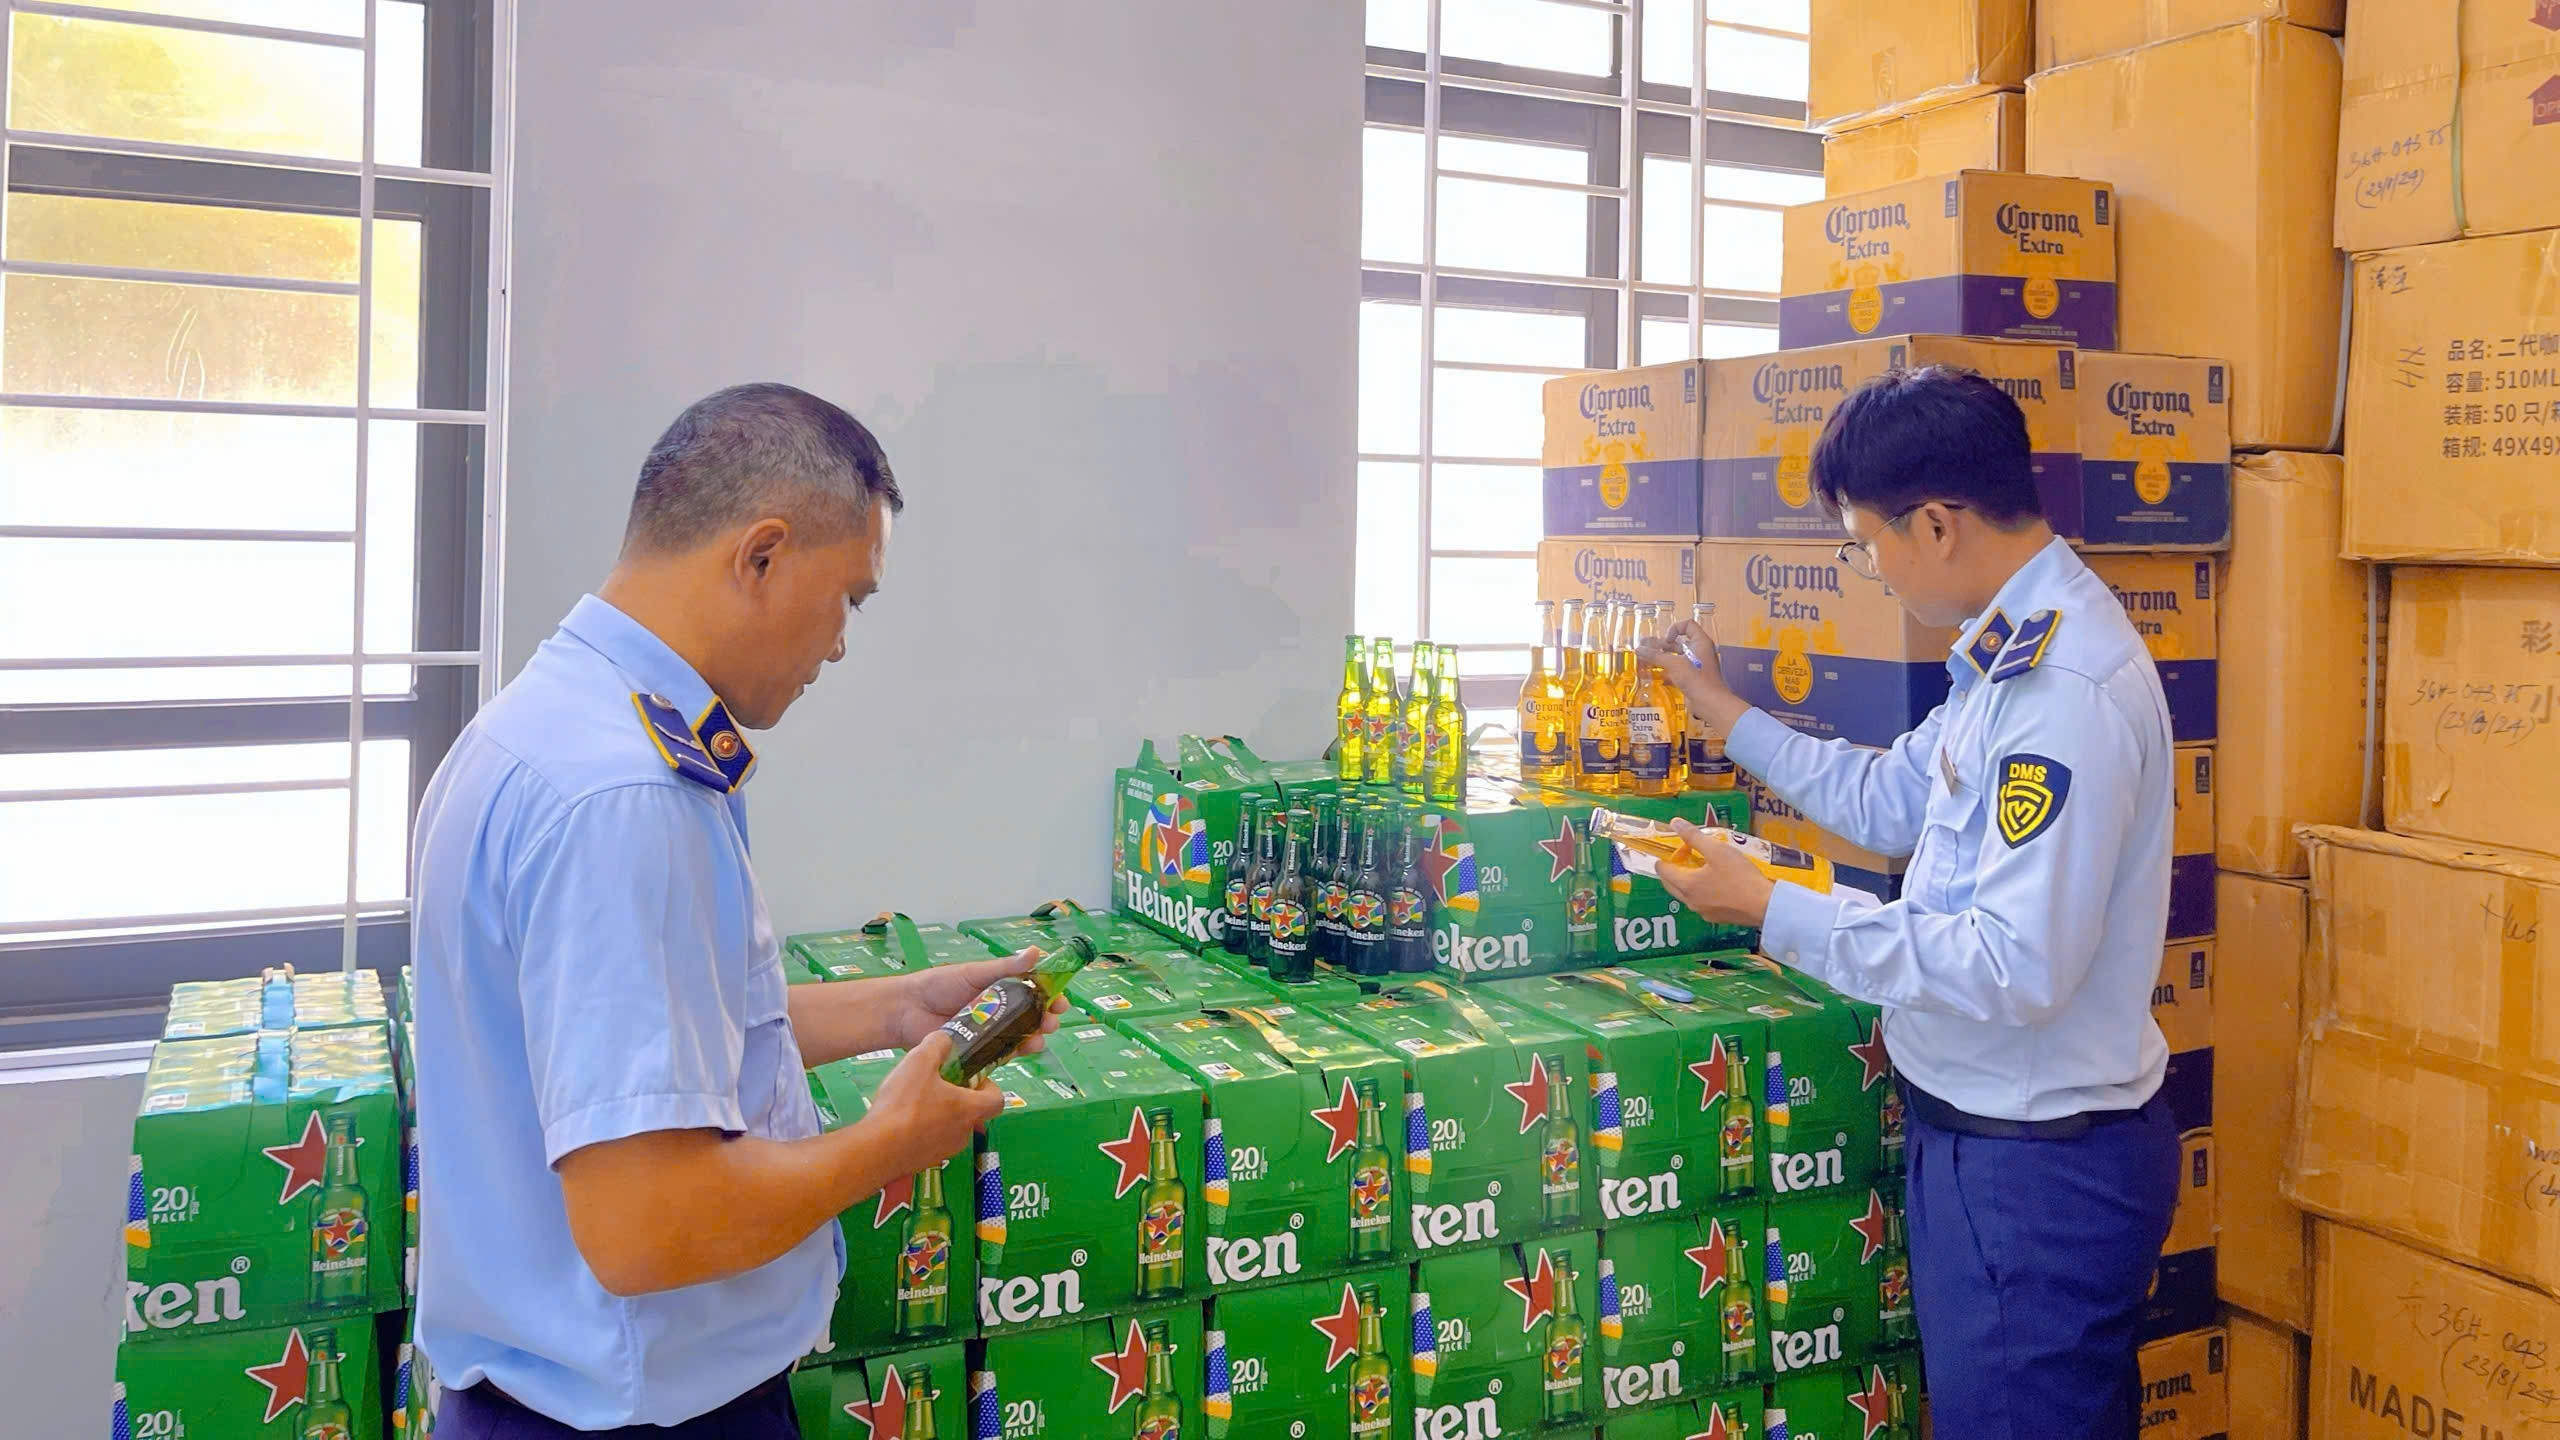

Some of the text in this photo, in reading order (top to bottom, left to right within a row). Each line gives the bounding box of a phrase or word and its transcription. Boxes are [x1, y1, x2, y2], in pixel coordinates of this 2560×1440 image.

[1825, 202, 1908, 243] Corona
[1996, 202, 2081, 235] Corona
[1845, 236, 1889, 260] Extra
[2019, 232, 2064, 255] Extra
[1753, 362, 1845, 404] Corona
[1991, 376, 2043, 402] rona
[1580, 384, 1652, 419] Corona
[1773, 398, 1823, 424] Extra
[2107, 382, 2191, 417] Corona
[1597, 414, 1636, 437] Extra
[2130, 413, 2176, 436] Extra
[1575, 549, 1649, 585] Corona
[1746, 554, 1841, 596] Corona
[1769, 592, 1820, 622] Extra
[2110, 584, 2177, 612] orona
[2008, 763, 2048, 783] DMS
[1212, 840, 1234, 858] 20
[1213, 858, 1229, 866] PAC
[1480, 866, 1502, 885] 20
[1126, 870, 1225, 942] Heineke
[1225, 914, 1247, 926] Heine
[1250, 920, 1270, 932] Hein
[1789, 1076, 1810, 1097] 20
[1623, 1096, 1647, 1118] 20
[1790, 1097, 1810, 1107] PACK
[1431, 1119, 1458, 1142] 20
[1625, 1117, 1646, 1128] PACK
[1433, 1141, 1457, 1152] PACK
[1231, 1146, 1260, 1172] 20
[1232, 1170, 1258, 1182] PACK
[151, 1186, 189, 1213] 20
[1009, 1182, 1040, 1210] 20
[152, 1212, 186, 1225] PACK
[1010, 1208, 1039, 1221] PACK
[1138, 1249, 1183, 1264] Heineken
[1787, 1252, 1810, 1274] 20
[1789, 1272, 1809, 1283] PACK
[897, 1285, 947, 1300] Heineken
[1620, 1284, 1645, 1308] 20
[1622, 1306, 1644, 1318] PACK
[1437, 1318, 1463, 1343] 20
[1232, 1358, 1260, 1384] 20
[1233, 1383, 1258, 1395] PACK
[2350, 1364, 2465, 1440] MADE
[135, 1410, 174, 1438] 20
[1004, 1400, 1036, 1428] 20
[1005, 1427, 1034, 1440] PACK
